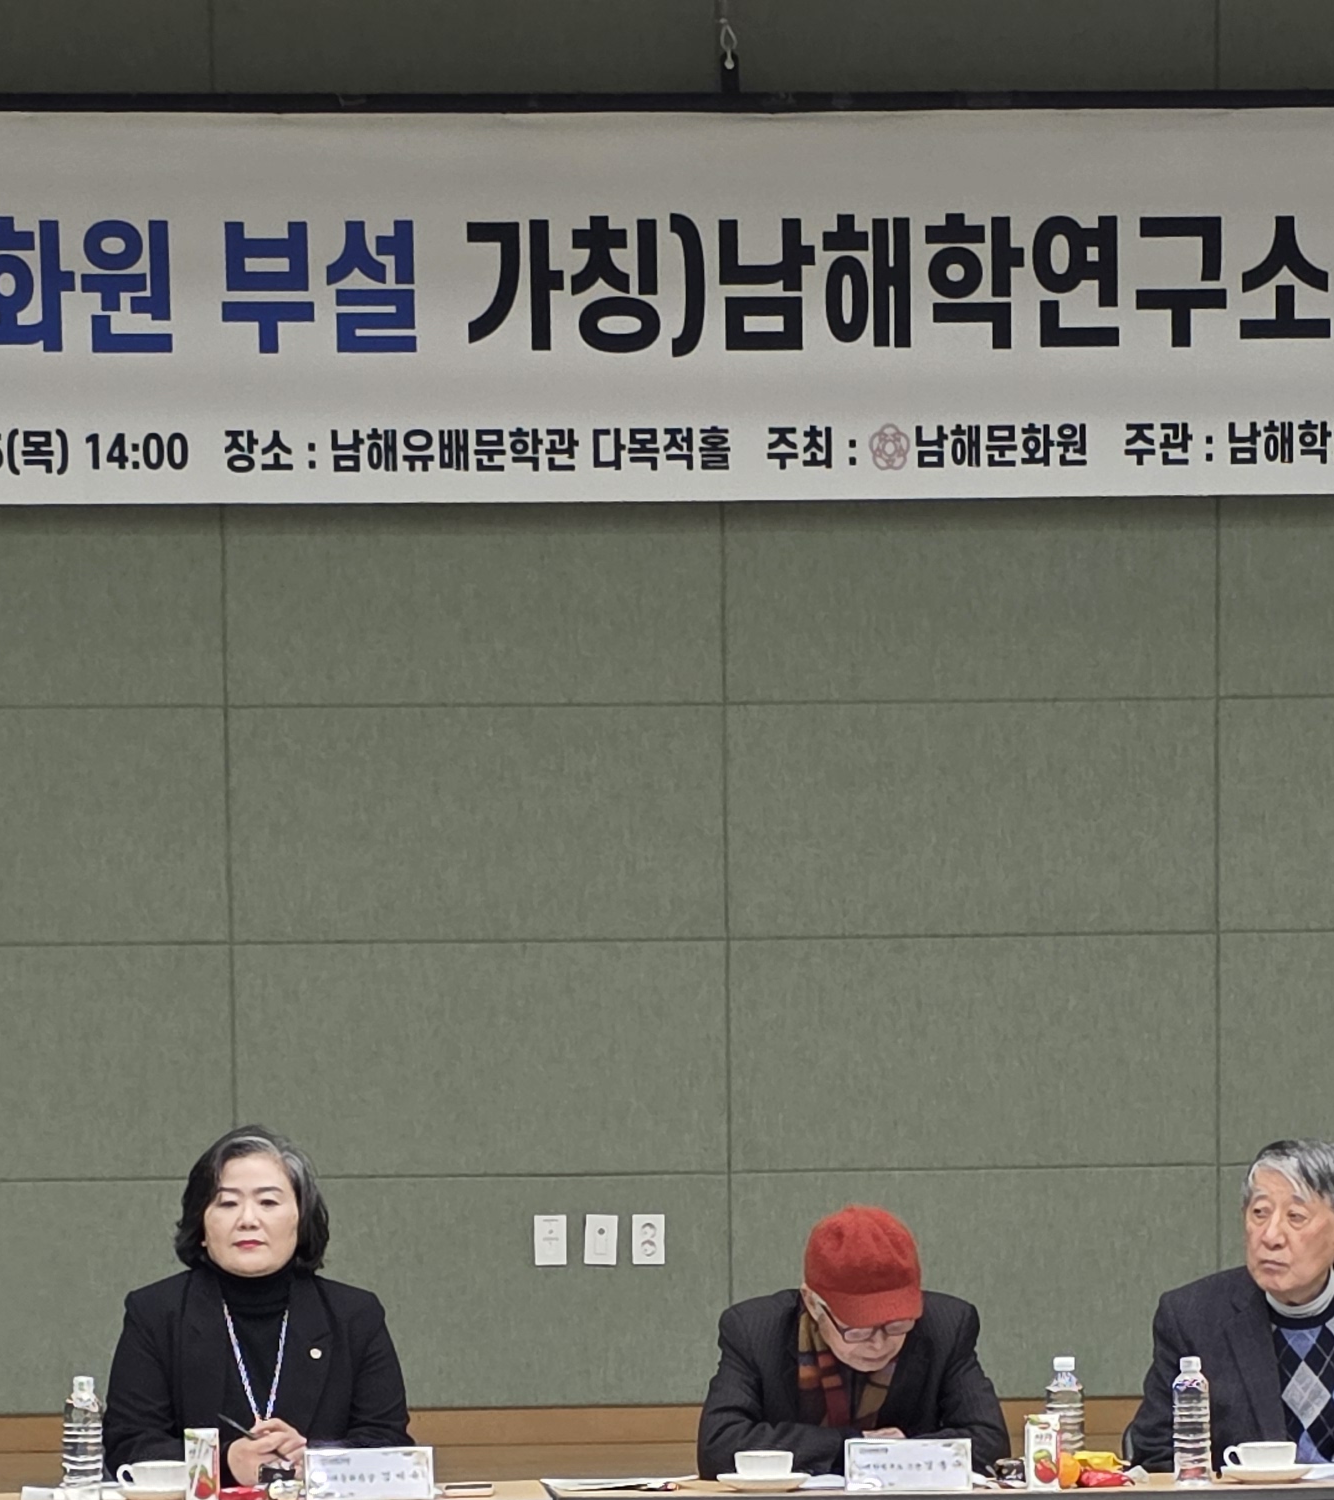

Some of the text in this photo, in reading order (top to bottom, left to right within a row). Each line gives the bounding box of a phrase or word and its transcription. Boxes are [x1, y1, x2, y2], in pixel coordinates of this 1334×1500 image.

[220, 218, 418, 355] 부설
[465, 211, 1332, 359] 가칭)남해학연구소
[84, 431, 190, 471] 14:00
[329, 426, 581, 474] 남해유배문학관
[591, 424, 732, 472] 다목적홀
[914, 421, 1089, 469] 남해문화원
